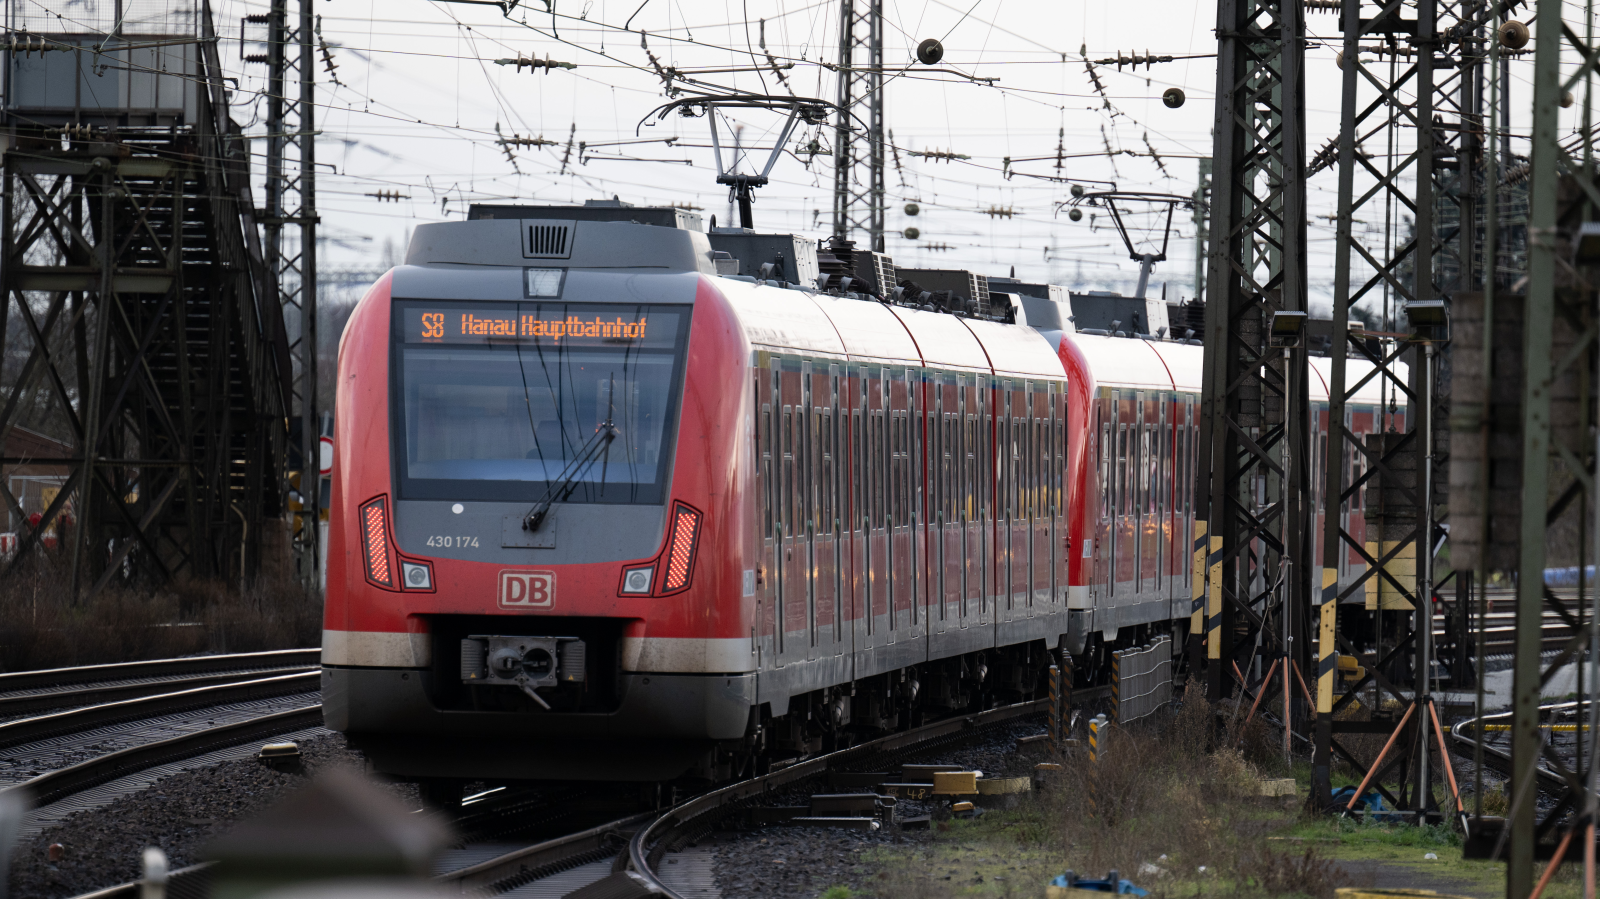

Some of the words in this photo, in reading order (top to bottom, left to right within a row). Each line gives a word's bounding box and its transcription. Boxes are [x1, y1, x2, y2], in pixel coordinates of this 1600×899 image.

[421, 312, 445, 338] S8
[461, 313, 517, 336] Hanau
[521, 314, 647, 341] Hauptbahnhof
[426, 535, 452, 548] 430
[455, 536, 480, 548] 174
[505, 576, 549, 604] DB
[907, 787, 926, 800] 48
